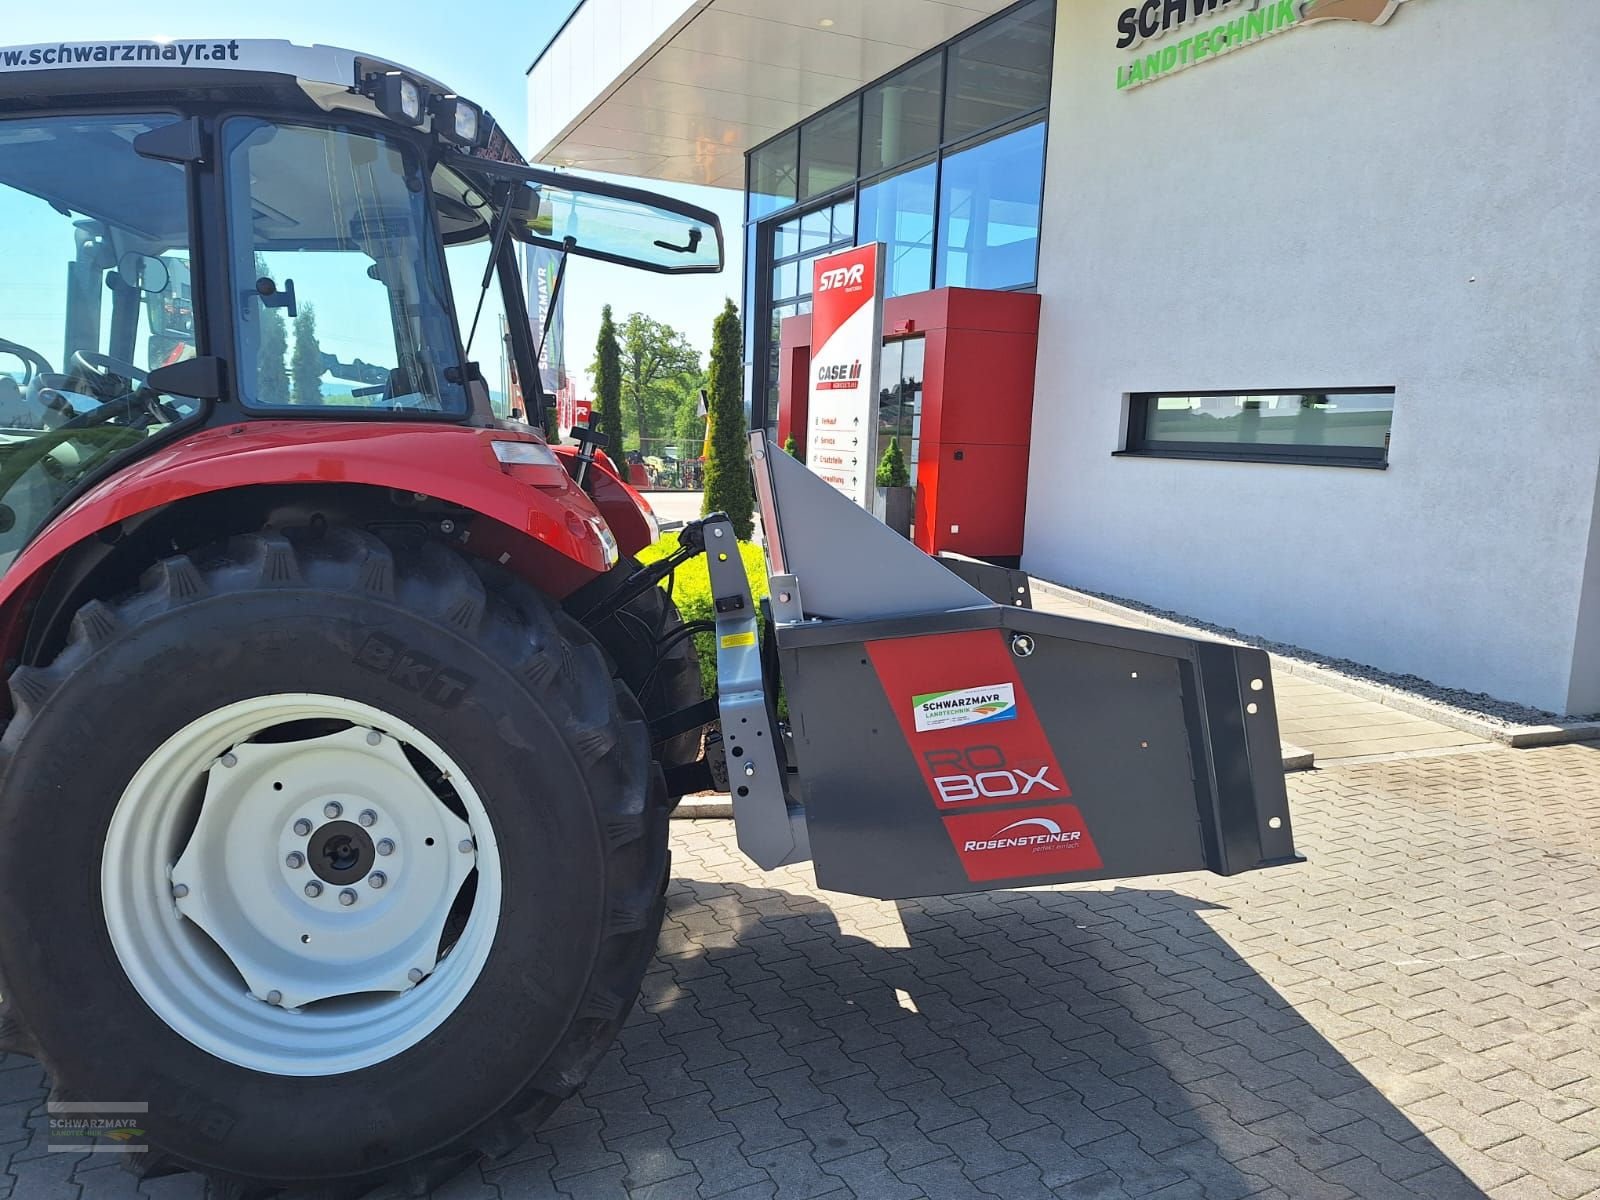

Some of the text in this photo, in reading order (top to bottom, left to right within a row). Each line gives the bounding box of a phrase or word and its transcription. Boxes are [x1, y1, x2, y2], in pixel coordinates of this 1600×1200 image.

[0, 39, 240, 66] w.schwarzmayr.at
[1116, 0, 1295, 89] LANDTECHNIK
[818, 263, 864, 291] STEYR
[818, 364, 848, 381] CASE
[923, 694, 1000, 712] SCHWARZMAYR
[925, 708, 971, 719] LANDTECHNIK
[924, 745, 1006, 773] RO
[934, 766, 1061, 803] BOX
